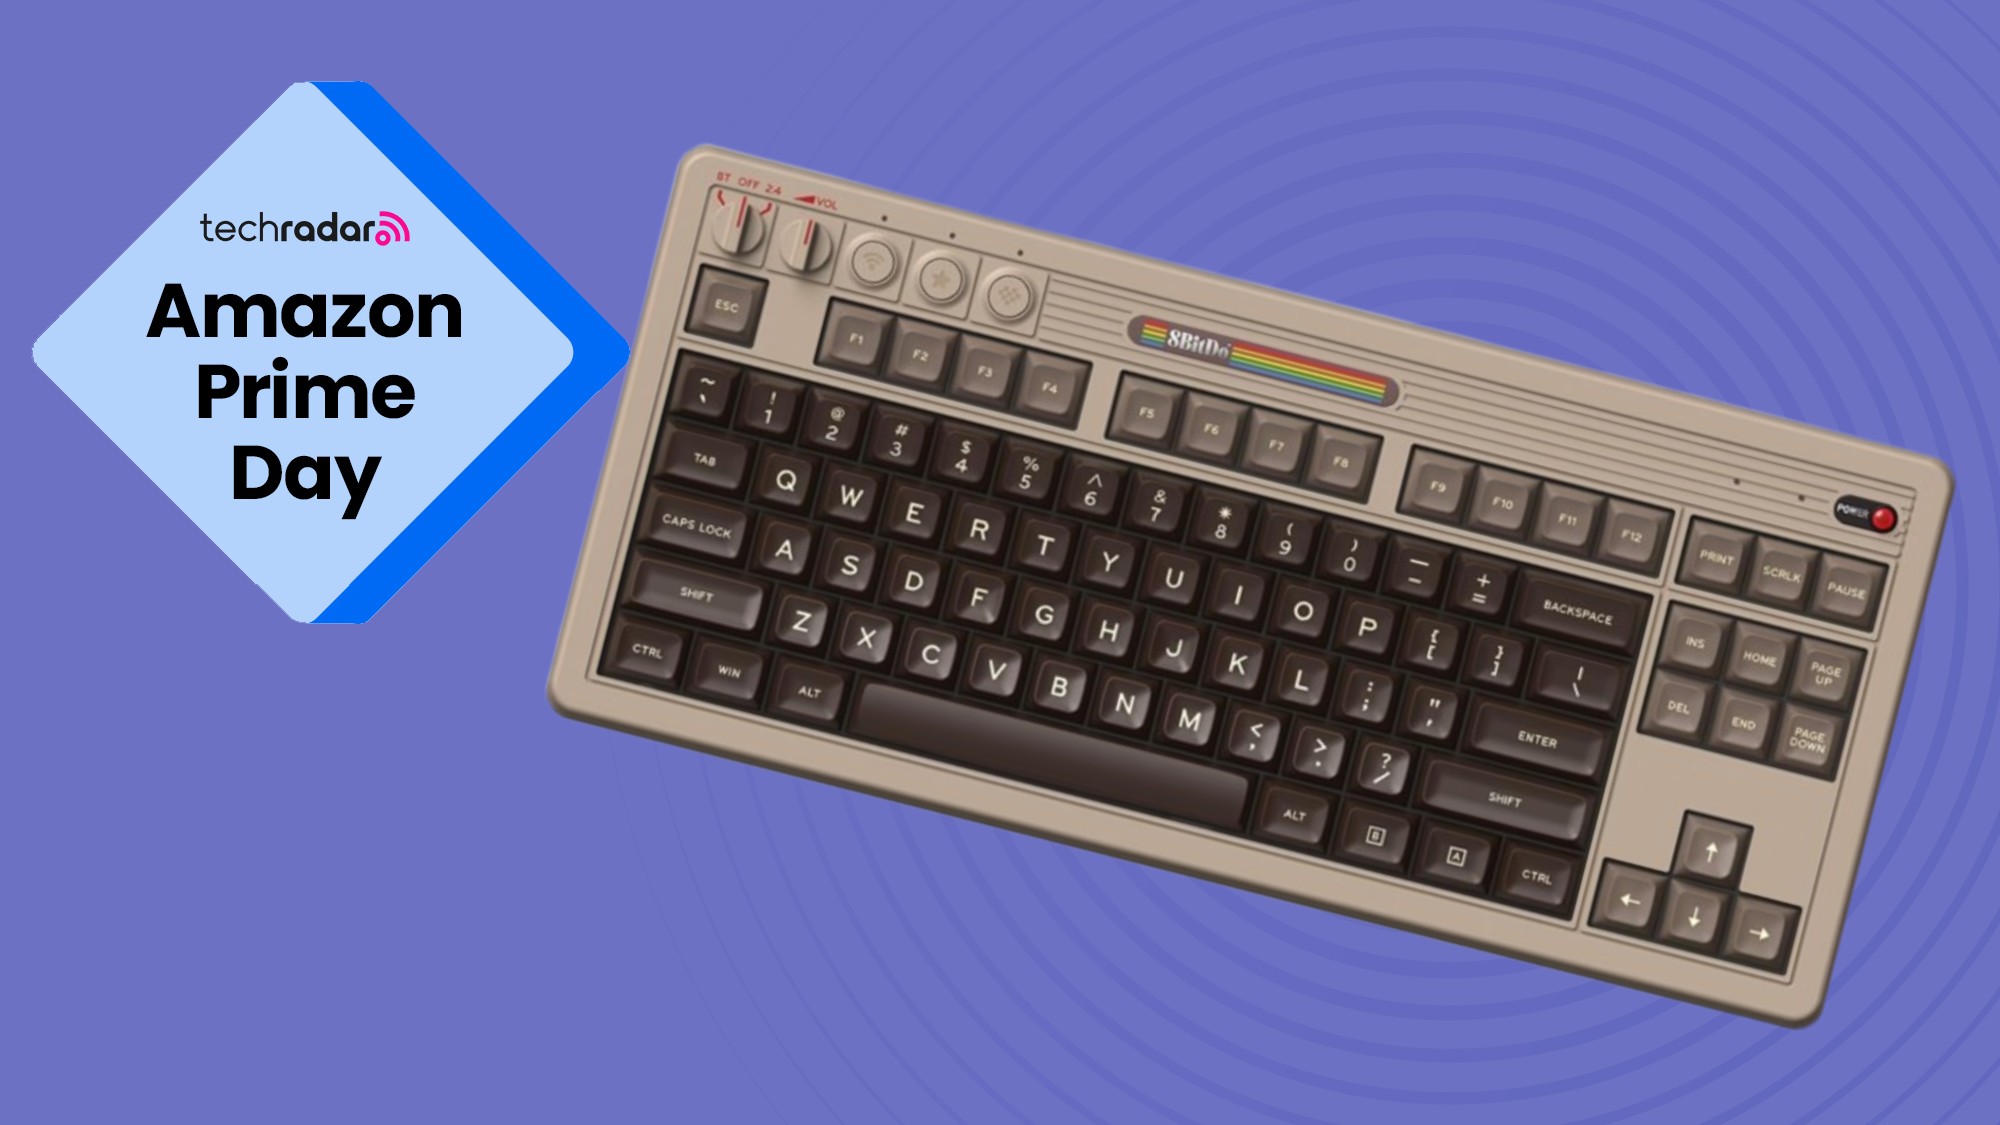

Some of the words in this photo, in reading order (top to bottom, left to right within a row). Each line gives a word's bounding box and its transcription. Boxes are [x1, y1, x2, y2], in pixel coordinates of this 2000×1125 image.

[716, 171, 732, 183] BT
[738, 176, 760, 190] OFF
[816, 196, 839, 212] VOL
[714, 298, 740, 313] ESC
[849, 332, 864, 346] F1
[913, 348, 930, 362] F2
[977, 364, 994, 379] F3
[1042, 381, 1058, 394] F4
[769, 390, 777, 405] !
[763, 408, 773, 425] 1
[830, 406, 845, 422] @
[1140, 406, 1156, 420] F5
[825, 424, 840, 442] 2
[894, 423, 909, 438] #
[1204, 422, 1220, 437] F6
[889, 440, 902, 458] 3
[961, 440, 971, 455] $
[1268, 439, 1285, 453] F7
[693, 452, 716, 467] TAB
[955, 457, 968, 474] 4
[1022, 454, 1040, 472] %
[1333, 455, 1350, 469] F8
[775, 468, 798, 493] Q
[1019, 474, 1031, 490] 5
[1430, 480, 1447, 494] F9
[840, 483, 864, 508] W
[1084, 490, 1096, 507] 6
[1153, 489, 1167, 503] &
[1492, 496, 1514, 511] F10
[905, 501, 925, 525] E
[1150, 507, 1161, 522] 7
[1558, 512, 1577, 527] F11
[662, 512, 695, 533] CAPS
[698, 521, 732, 541] LOCK
[969, 518, 990, 541] R
[1214, 523, 1227, 539] 8
[1286, 521, 1293, 536] (
[1037, 534, 1055, 556] T
[1351, 537, 1359, 552] )
[1621, 529, 1643, 544] F12
[775, 538, 794, 562] A
[1278, 539, 1292, 556] 9
[841, 554, 859, 576] S
[1103, 551, 1119, 573] Y
[1700, 549, 1735, 568] PRINT
[905, 570, 924, 592] D
[1166, 569, 1184, 588] U
[1476, 574, 1491, 588] +
[1762, 564, 1801, 584] SCRLK
[680, 585, 714, 604] SHIFT
[970, 586, 989, 608] F
[1472, 593, 1488, 604] =
[1827, 581, 1866, 601] PAUSE
[1034, 604, 1055, 626] G
[1293, 601, 1313, 621] O
[1543, 600, 1613, 625] BACKSPACE
[791, 610, 812, 633] Z
[1359, 618, 1377, 639] P
[856, 625, 877, 649] X
[1100, 621, 1119, 643] H
[1430, 628, 1439, 644] {
[632, 643, 663, 660] CTRL
[1166, 638, 1183, 658] J
[1686, 636, 1706, 650] INS
[921, 643, 941, 665] C
[1426, 644, 1435, 661] [
[1495, 646, 1504, 660] }
[1743, 650, 1777, 668] HOME
[718, 663, 741, 679] WIN
[987, 658, 1007, 681] V
[1228, 653, 1248, 677] K
[1490, 661, 1499, 677] ]
[1811, 661, 1843, 679] PAGE
[1051, 675, 1069, 698] B
[1294, 670, 1310, 692] L
[1367, 681, 1374, 692] :
[1815, 674, 1833, 687] UP
[798, 684, 821, 699] ALT
[1116, 693, 1135, 714] N
[1667, 700, 1691, 716] DEL
[1179, 709, 1202, 733] M
[1731, 715, 1757, 732] END
[1250, 723, 1263, 738] <
[1794, 726, 1826, 745] PAGE
[1314, 739, 1328, 754] >
[1517, 730, 1557, 749] ENTER
[1789, 736, 1826, 755] DOWN
[1380, 753, 1392, 770] ?
[1373, 772, 1391, 784] /
[1488, 791, 1522, 809] SHIFT
[1283, 808, 1307, 822] ALT
[1372, 831, 1380, 842] B
[1452, 850, 1463, 862] A
[1522, 869, 1554, 887] CTRL
